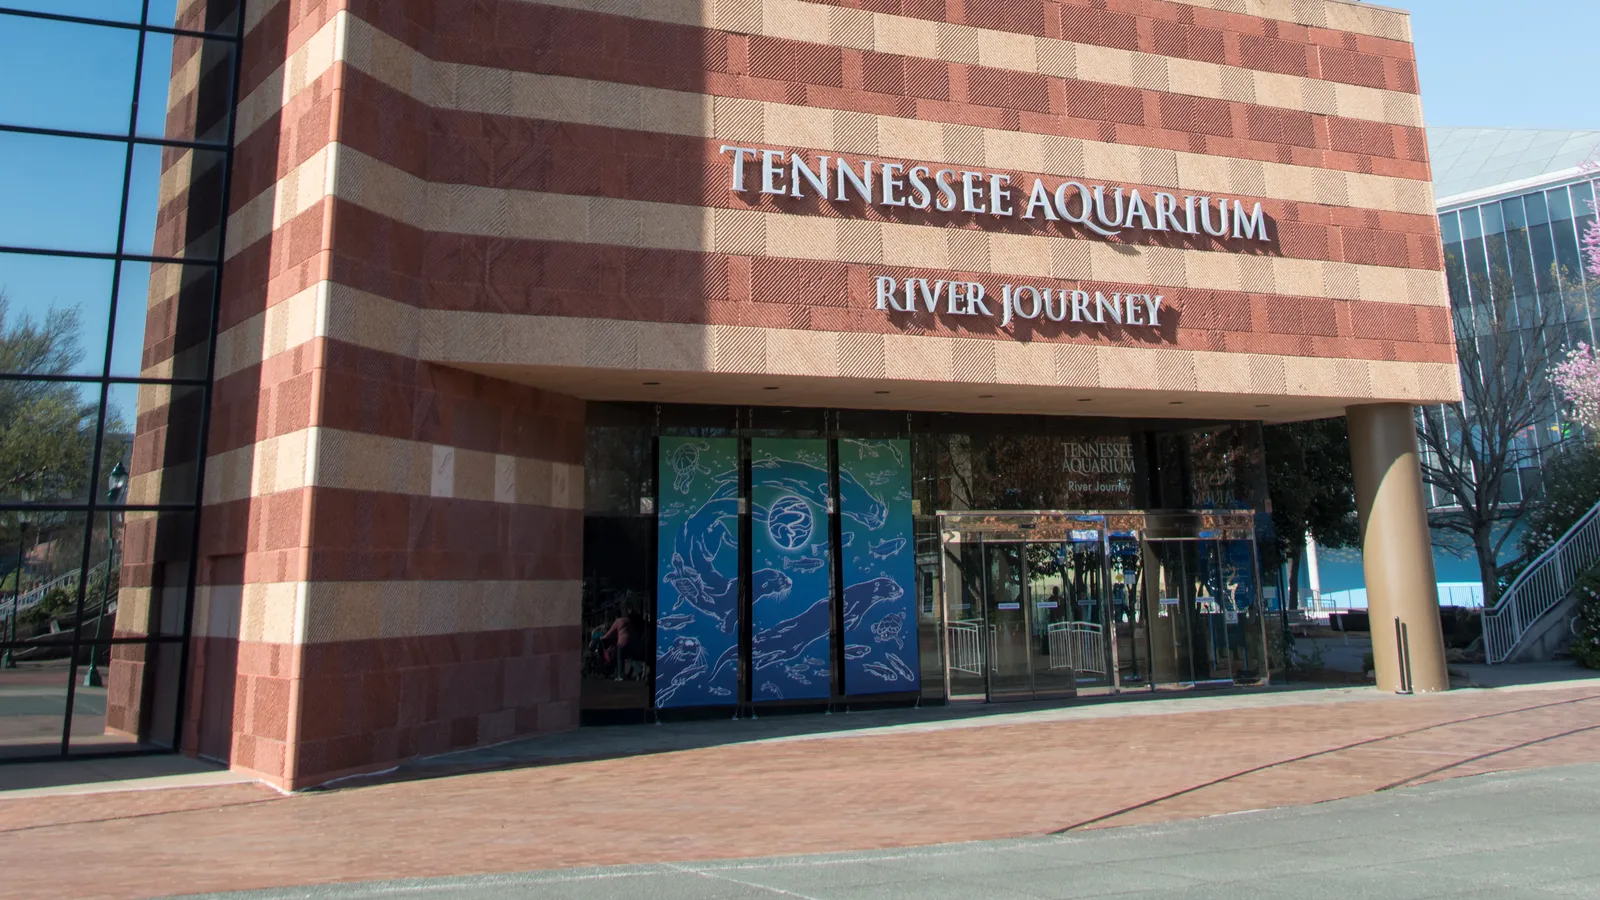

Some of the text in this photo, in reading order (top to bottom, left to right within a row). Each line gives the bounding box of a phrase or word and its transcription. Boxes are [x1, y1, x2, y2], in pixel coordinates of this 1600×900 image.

[719, 145, 1271, 241] TENNESSEE AQUARIUM
[874, 275, 1163, 327] RIVER JOURNEY
[1060, 442, 1134, 458] TENNESSEE
[1062, 458, 1136, 476] AQUARIUM
[1068, 481, 1131, 493] River Journey
